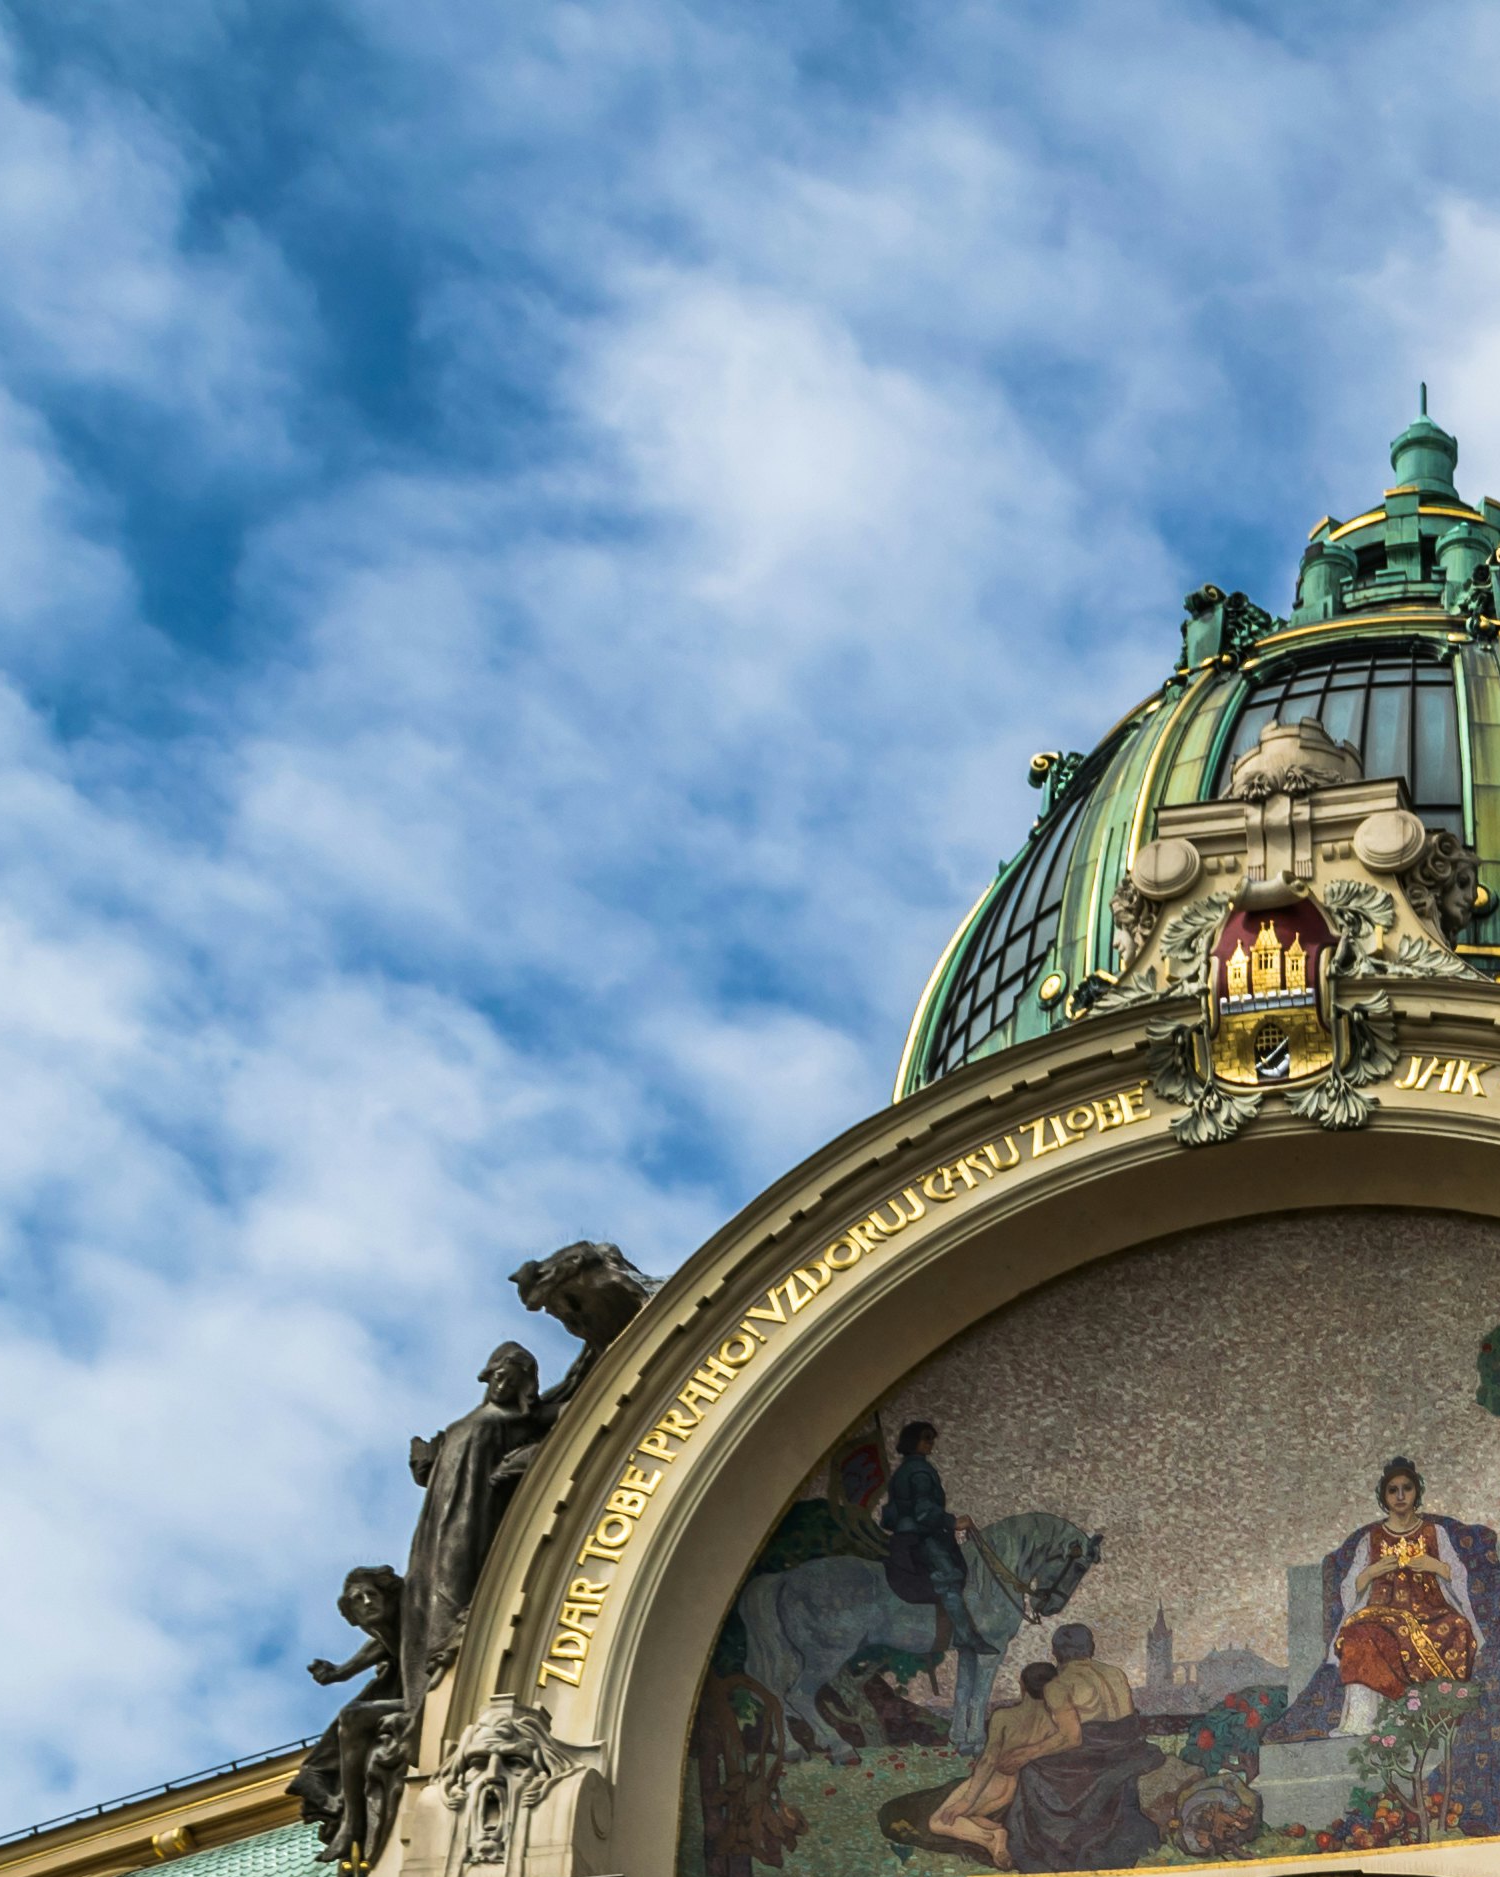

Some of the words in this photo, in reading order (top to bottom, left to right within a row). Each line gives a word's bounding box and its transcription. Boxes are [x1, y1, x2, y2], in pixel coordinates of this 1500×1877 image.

[1394, 1055, 1495, 1097] JAK
[537, 1576, 609, 1688] ZDAR
[637, 1320, 768, 1463] PRAHO!
[746, 1187, 927, 1324] VZDORUJ
[915, 1135, 1021, 1202] ČASU
